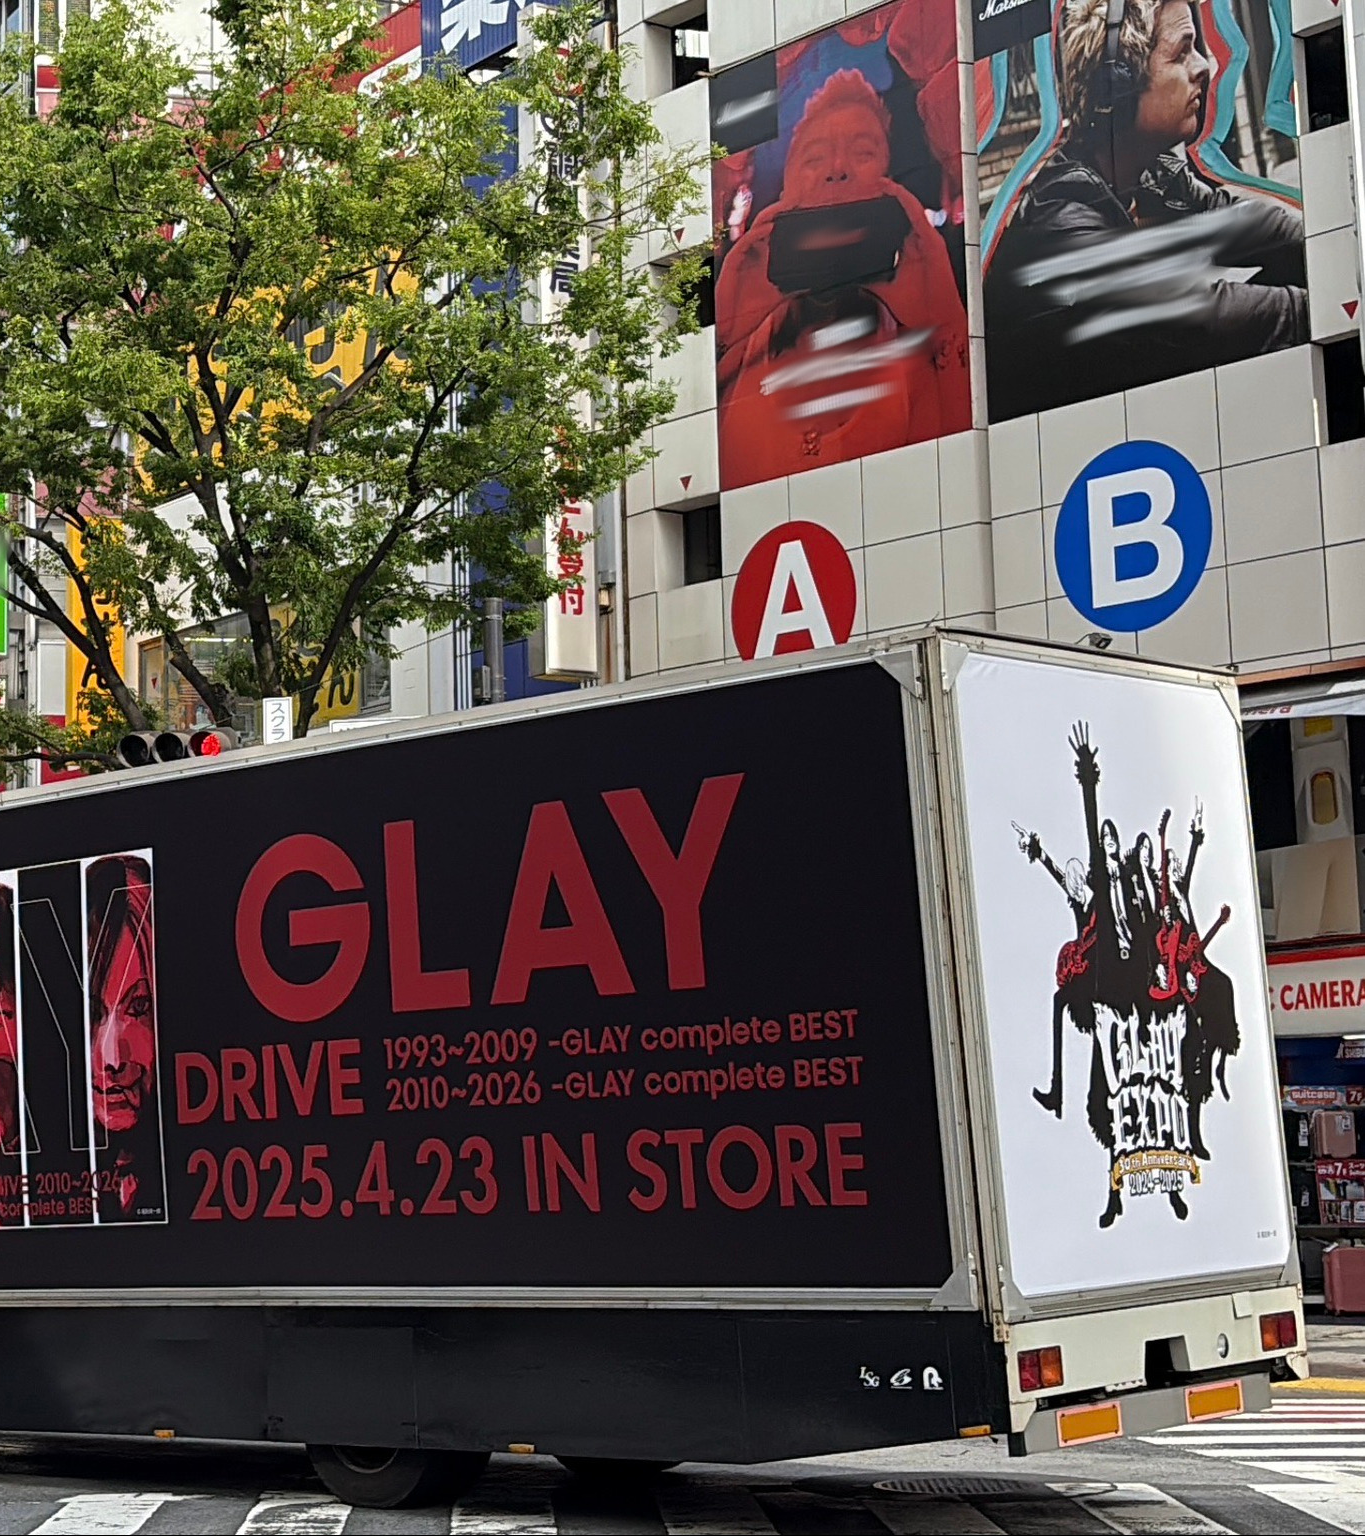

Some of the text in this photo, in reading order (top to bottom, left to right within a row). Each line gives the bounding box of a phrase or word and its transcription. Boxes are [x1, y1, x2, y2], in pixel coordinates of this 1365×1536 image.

[1087, 467, 1184, 609] B
[754, 539, 836, 661] A
[236, 773, 744, 1022] GLAY
[1280, 979, 1365, 1011] CAMERA
[383, 1009, 858, 1070] 1993~2009 -GLAY complete BEST
[1092, 1002, 1187, 1094] GLAY
[175, 1039, 364, 1124] DRIVE
[386, 1056, 864, 1111] 2010~2026 -GLAY complete BEST
[1107, 1081, 1192, 1155] EXPO
[187, 1122, 869, 1220] 2025.4.23 IN STORE
[1119, 1154, 1192, 1173] 30th Anniversary
[1129, 1170, 1184, 1196] 2024-2025
